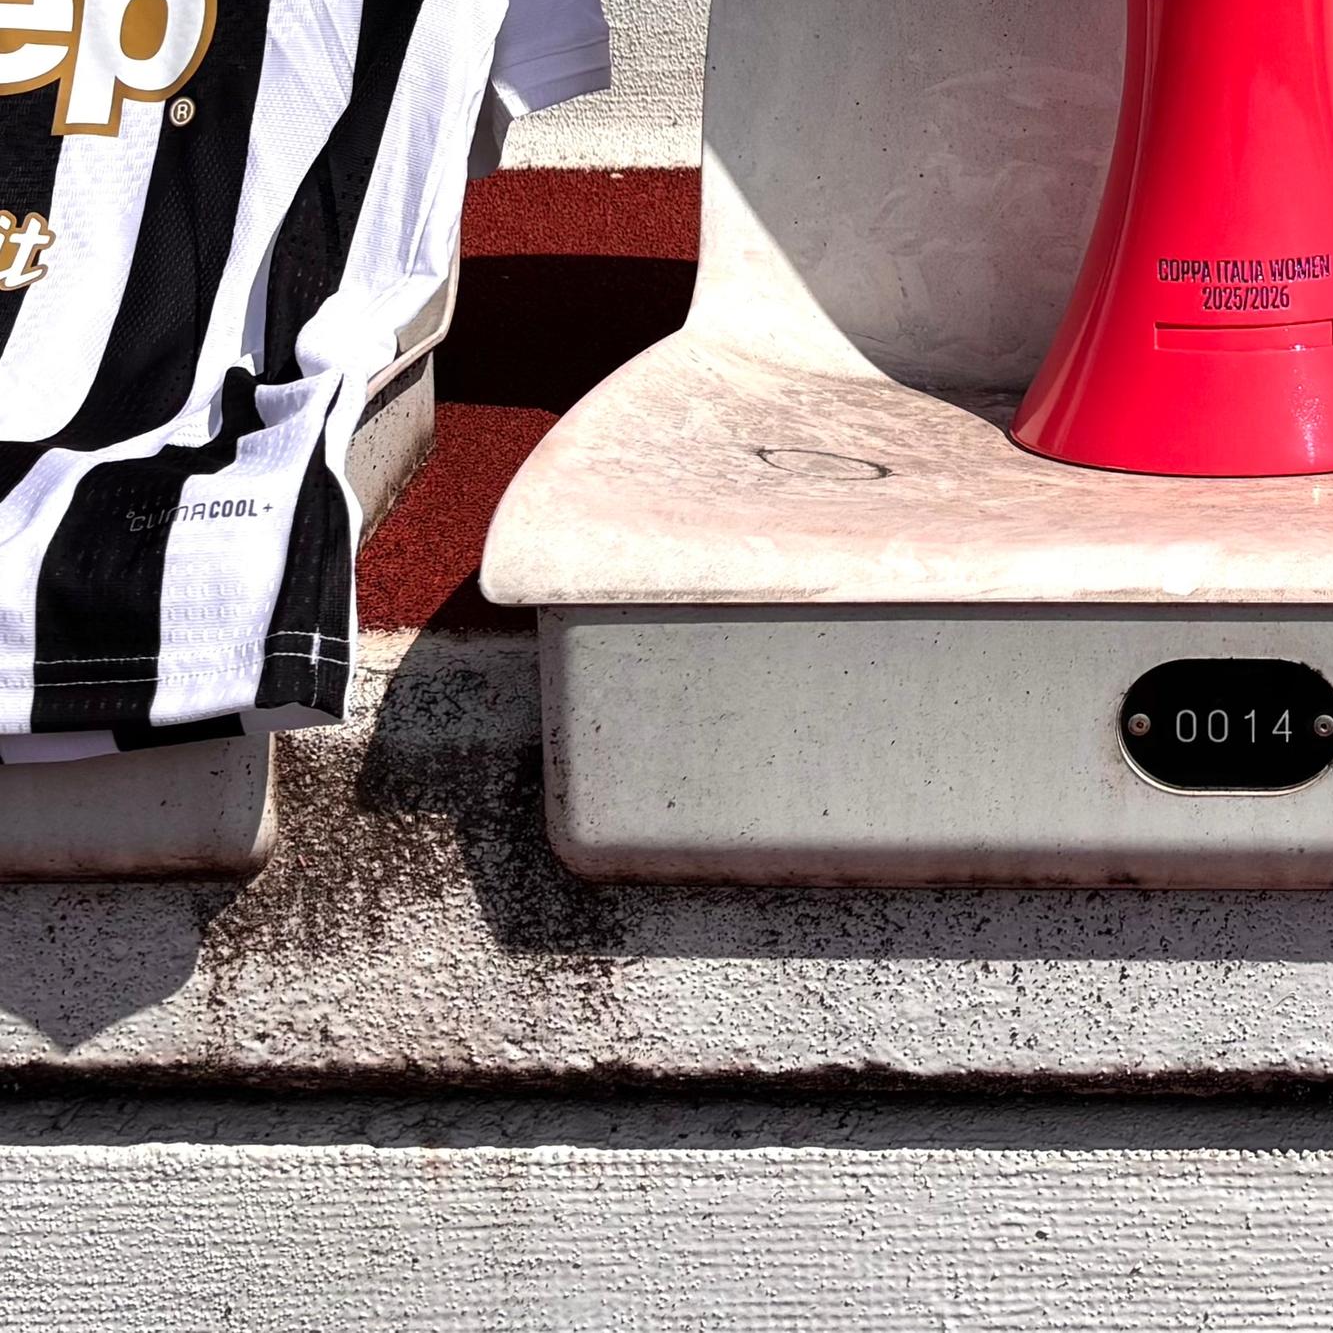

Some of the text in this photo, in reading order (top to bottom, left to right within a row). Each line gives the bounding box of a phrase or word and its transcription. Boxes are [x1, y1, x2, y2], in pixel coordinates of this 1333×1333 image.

[1158, 254, 1331, 283] COPPA ITALIA WOMEN
[1202, 285, 1290, 310] 2025/2026
[1176, 709, 1293, 743] 0014
